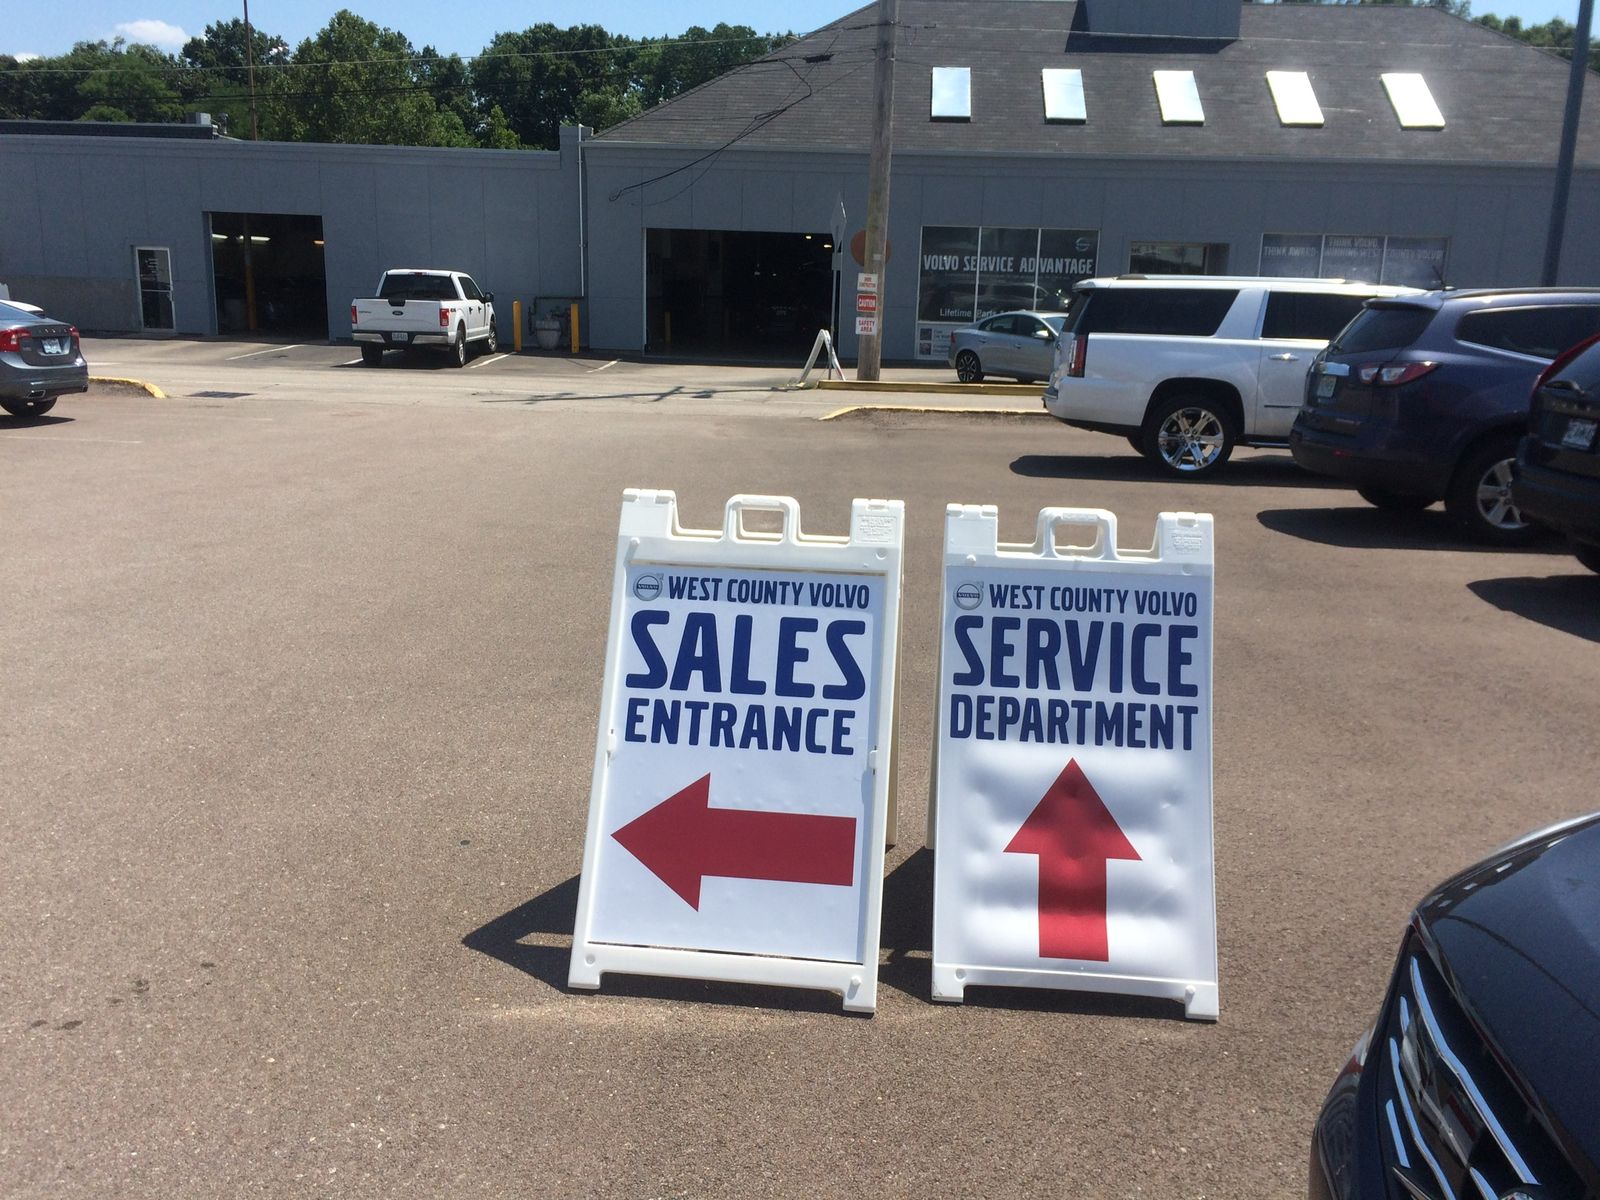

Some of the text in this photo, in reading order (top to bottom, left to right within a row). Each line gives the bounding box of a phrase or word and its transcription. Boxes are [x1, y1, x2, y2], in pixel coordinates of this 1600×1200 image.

[923, 255, 1093, 274] VOLVO SERVICE ADVANTAGE
[940, 308, 972, 317] Lifetime
[668, 576, 870, 609] WEST COUNTY VOLVO
[989, 584, 1198, 617] WEST COUNTY VOLVO
[626, 610, 866, 700] SALES
[953, 615, 1198, 697] SERVICE
[625, 698, 855, 755] ENTRANCE
[950, 694, 1198, 750] DEPARTMENT
